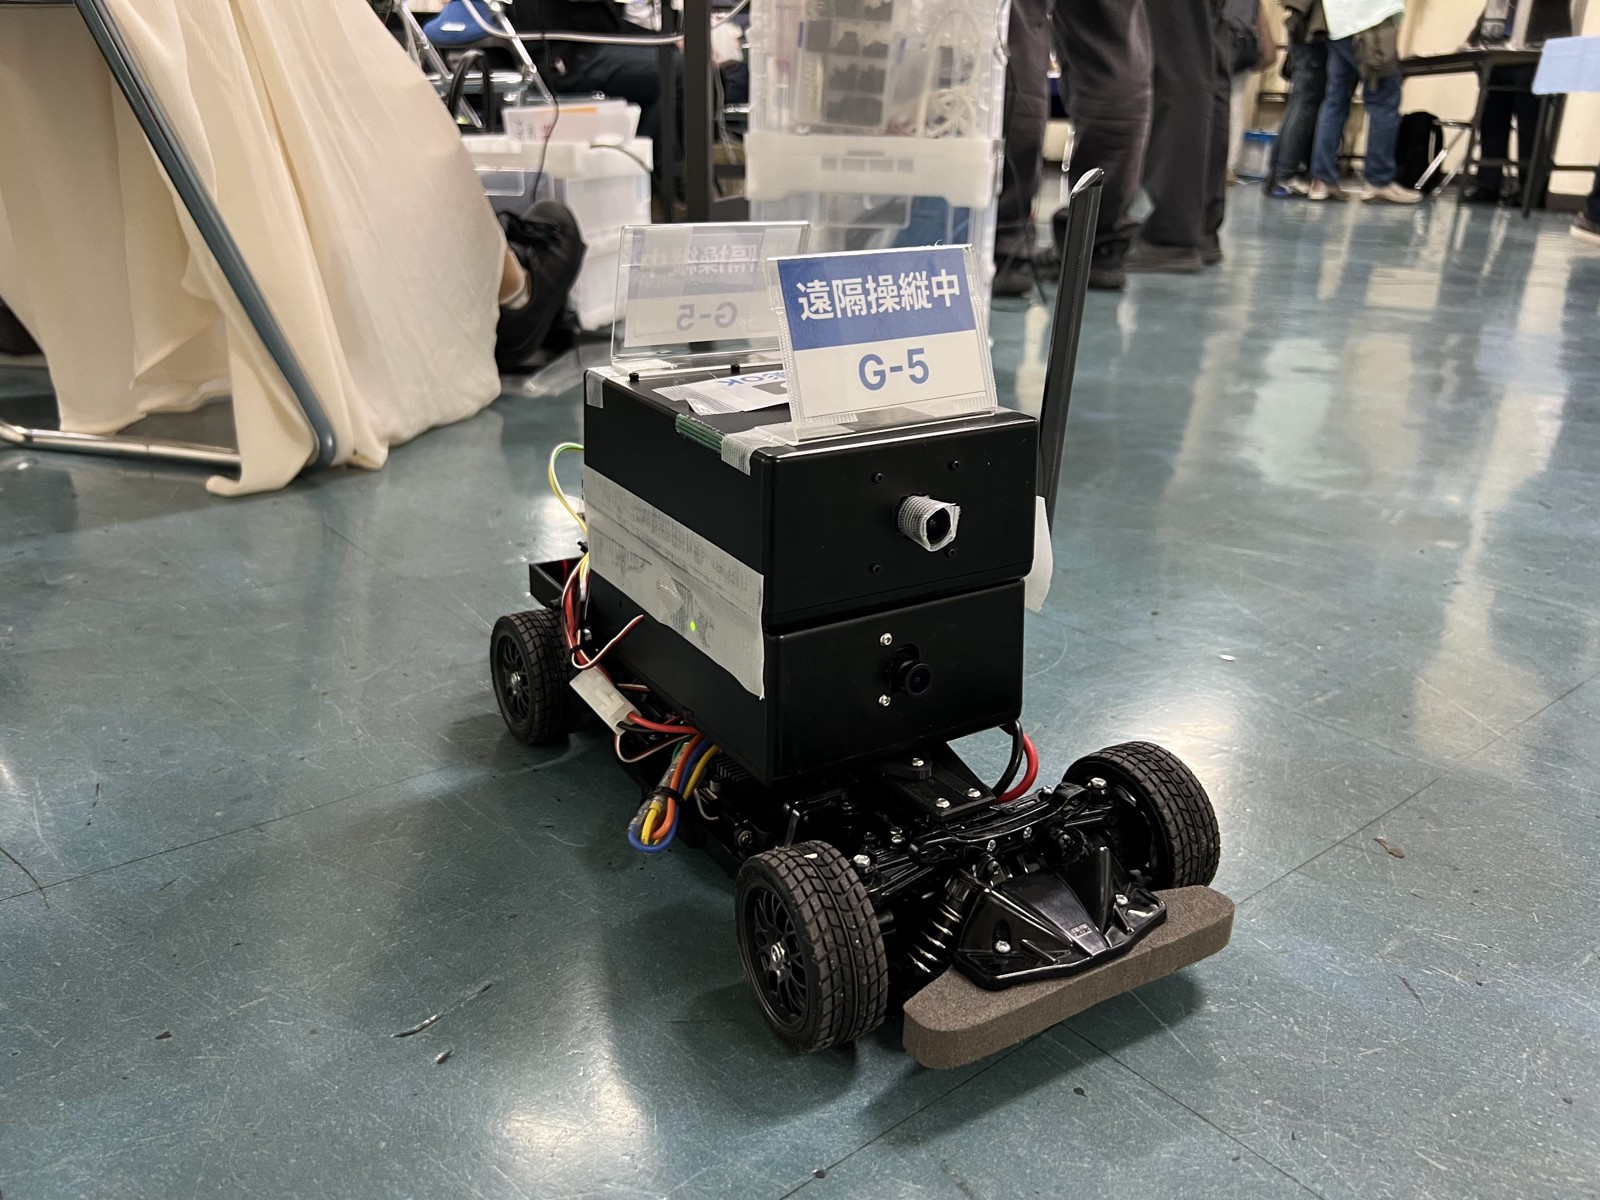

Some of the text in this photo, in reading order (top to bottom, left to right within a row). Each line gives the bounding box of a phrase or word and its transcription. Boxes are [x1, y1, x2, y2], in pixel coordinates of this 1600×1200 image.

[796, 269, 961, 321] 遠隔操縦中
[858, 347, 930, 391] G-5
